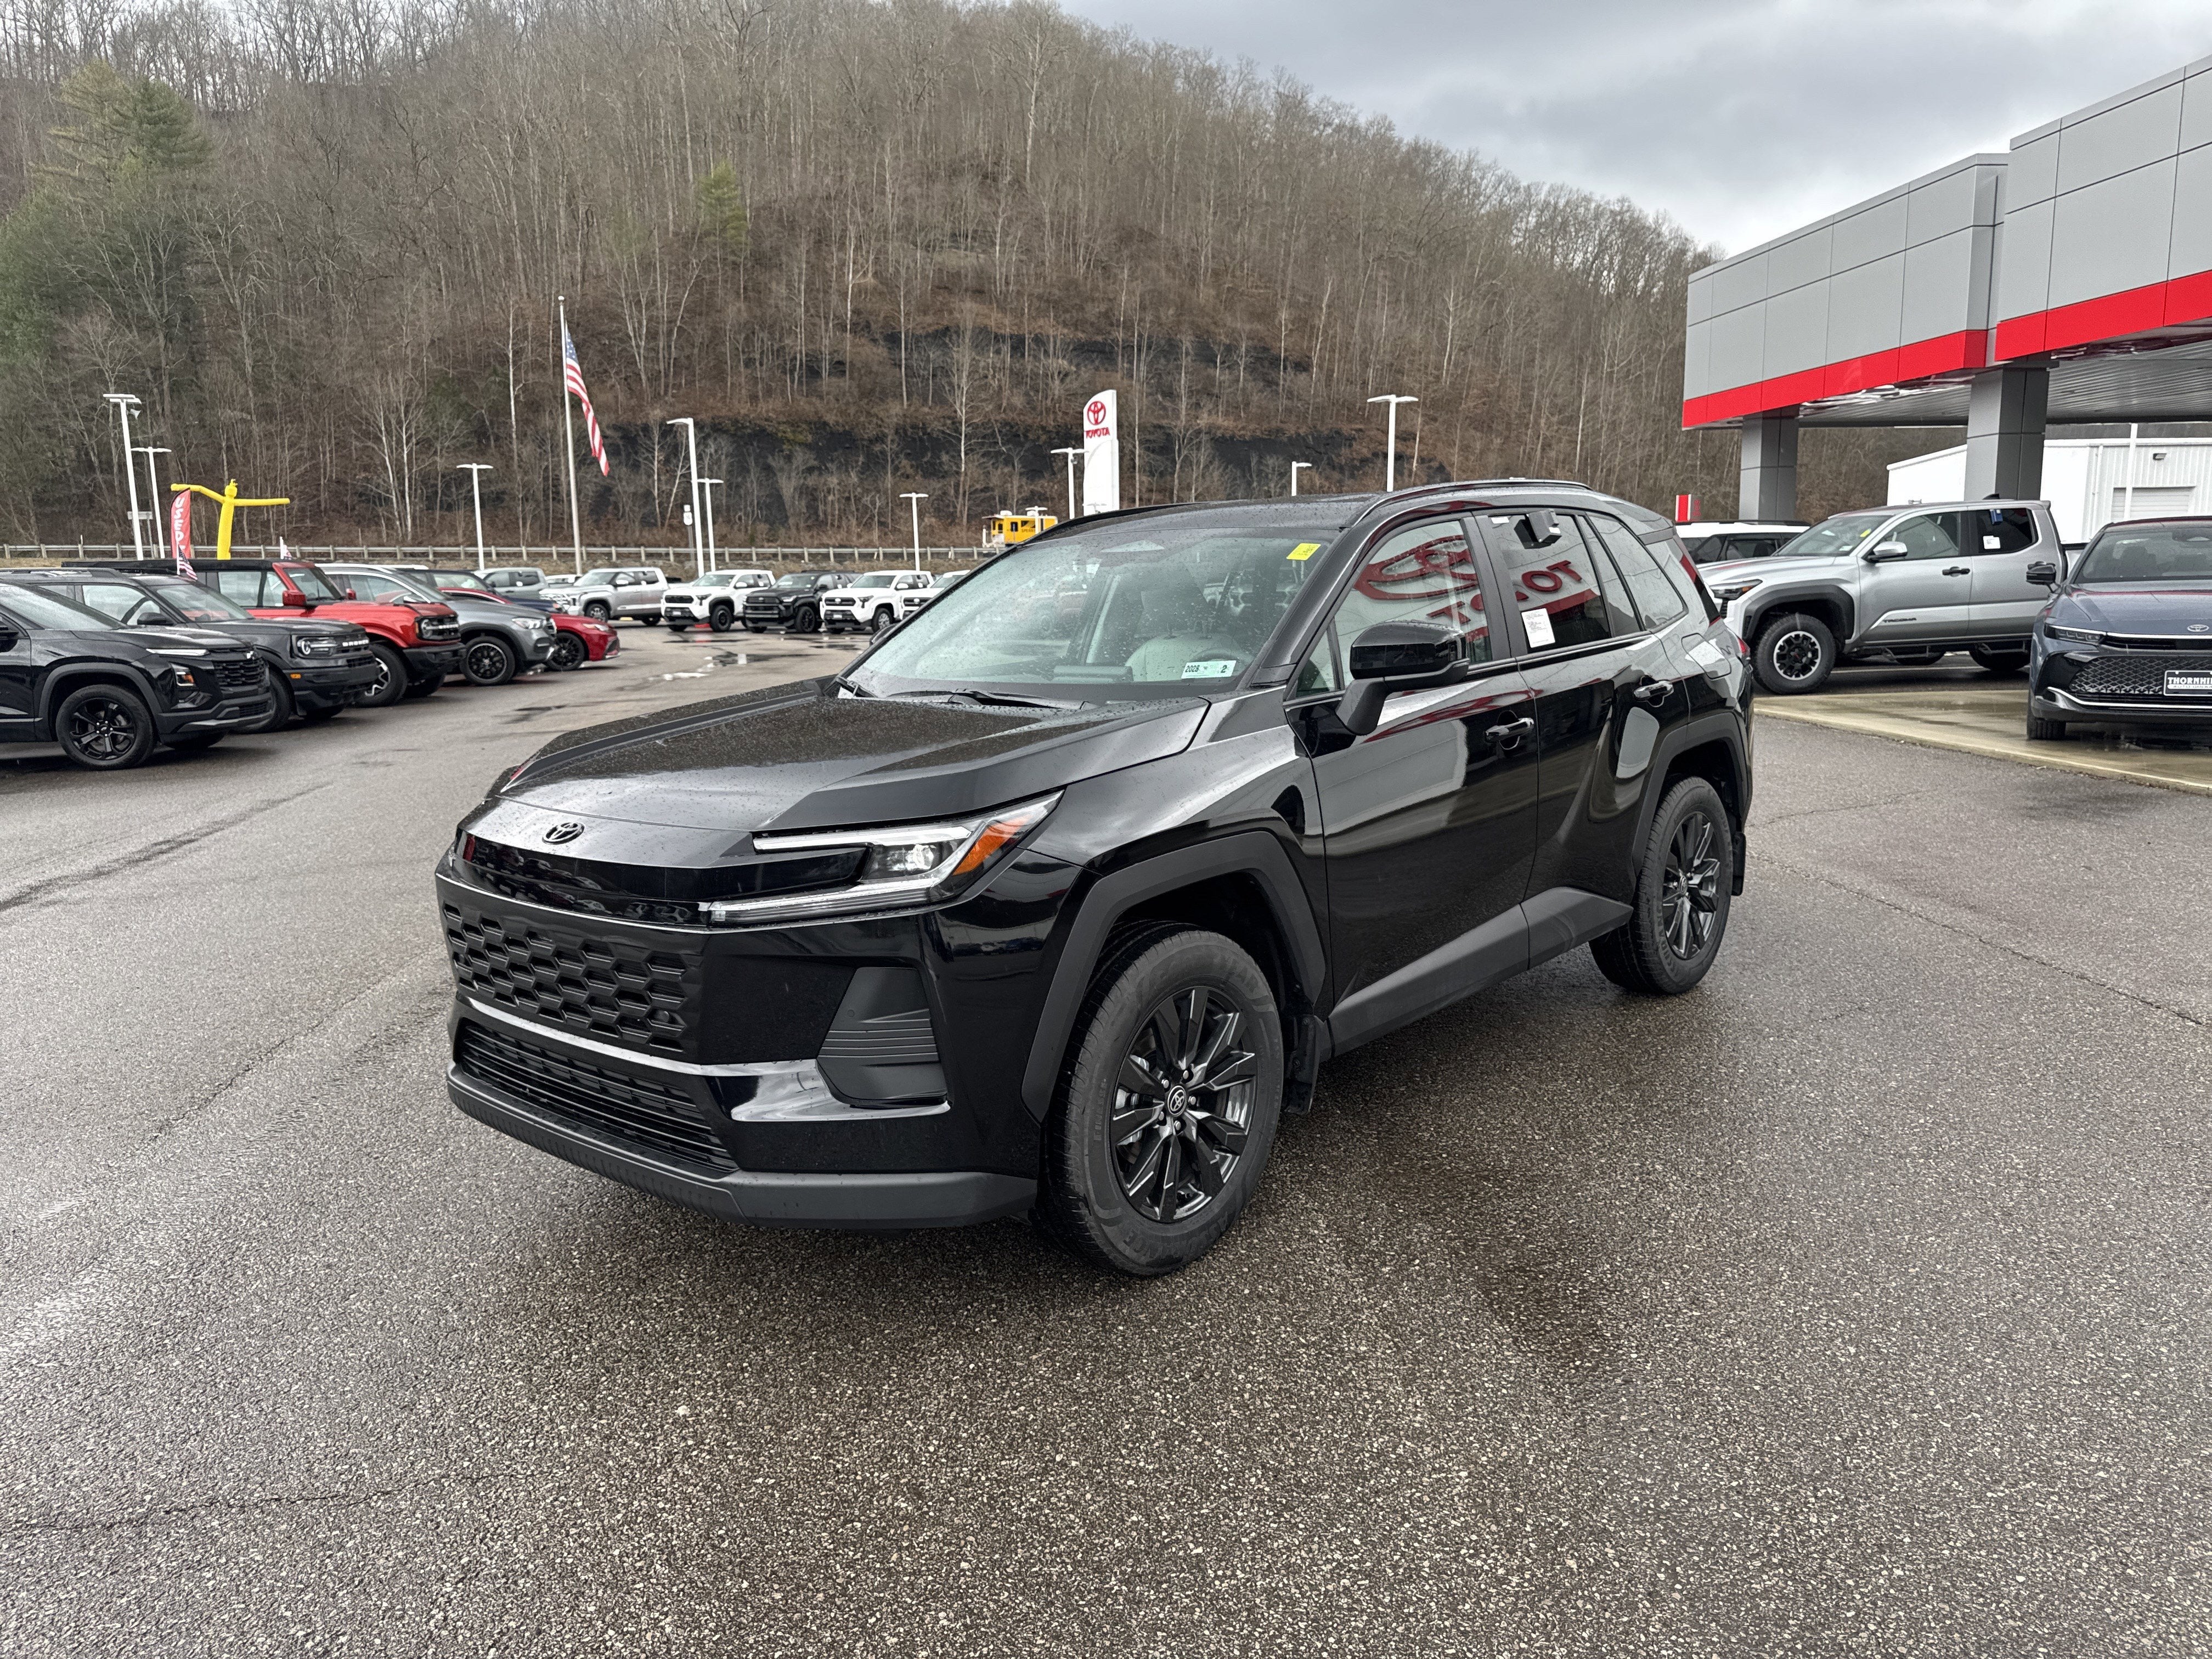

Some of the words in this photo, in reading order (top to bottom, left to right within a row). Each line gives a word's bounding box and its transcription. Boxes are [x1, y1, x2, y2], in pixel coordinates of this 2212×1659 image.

[1086, 427, 1110, 438] TOYOTA
[174, 496, 185, 541] USED
[1221, 665, 1227, 673] 2
